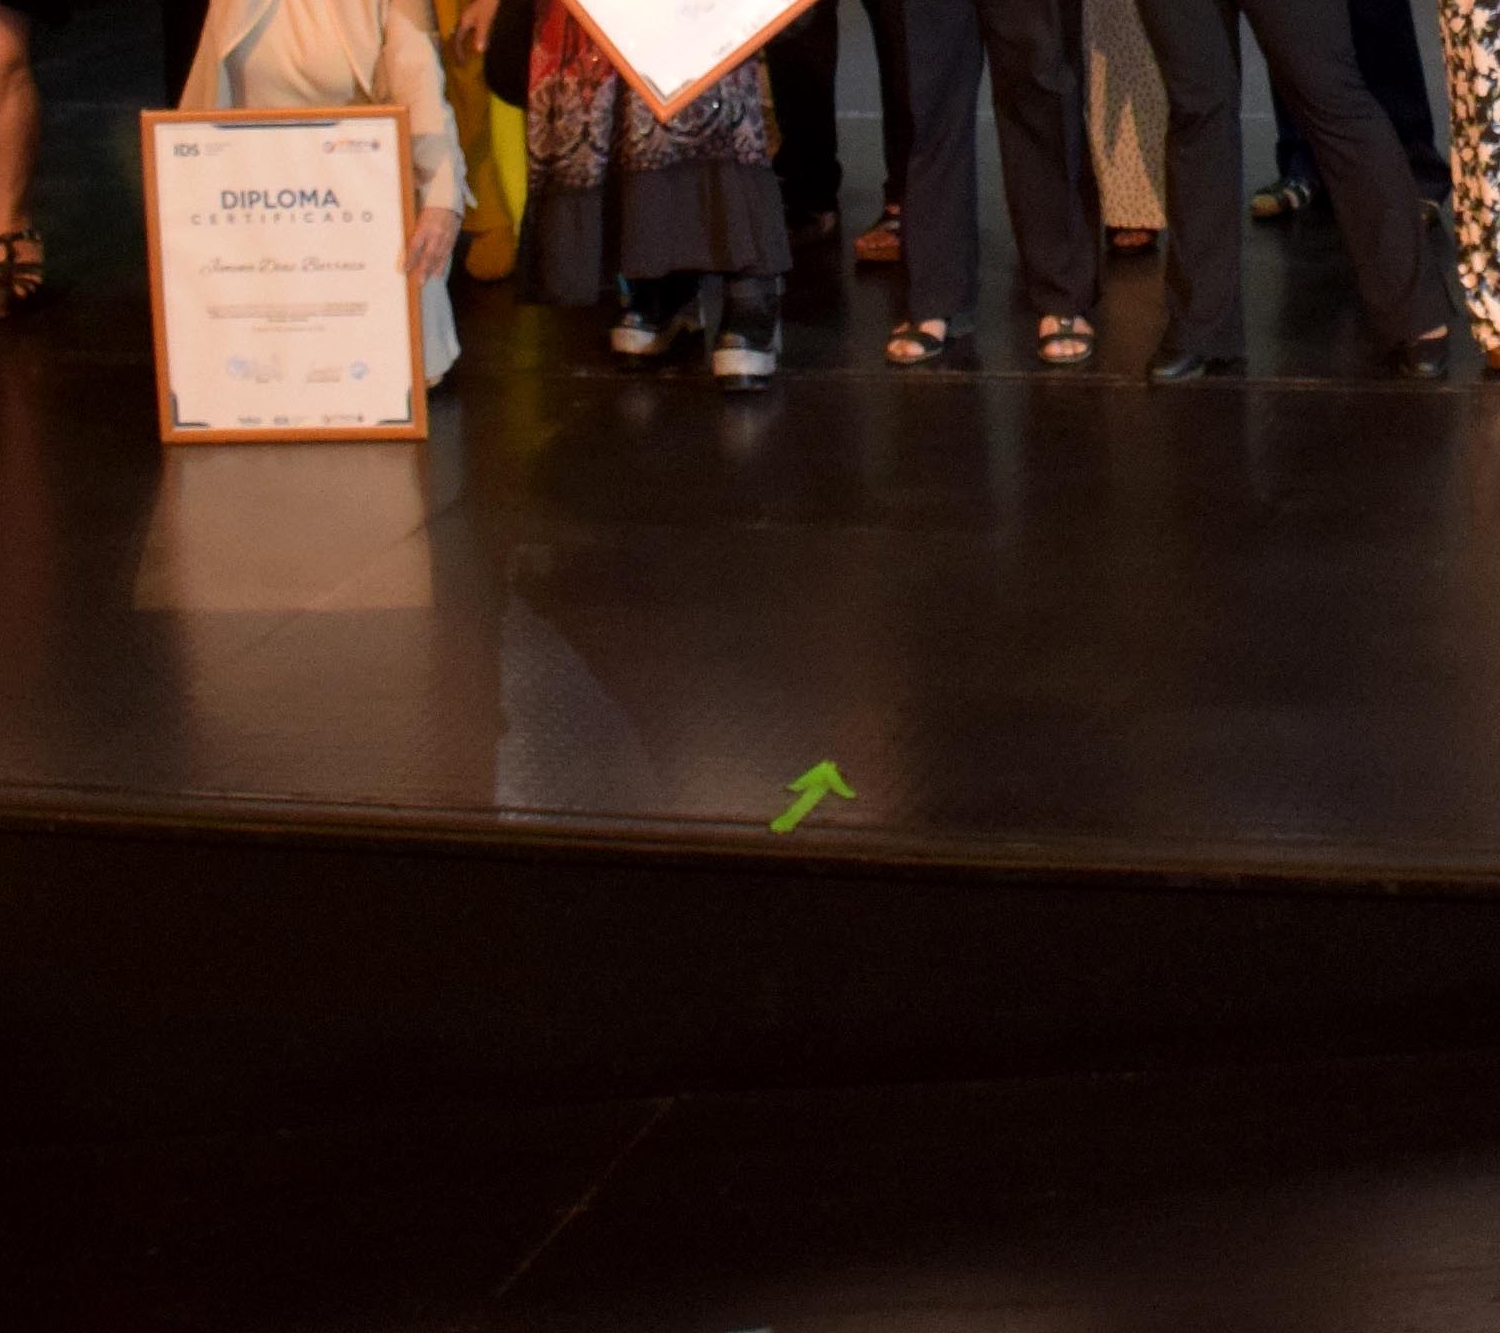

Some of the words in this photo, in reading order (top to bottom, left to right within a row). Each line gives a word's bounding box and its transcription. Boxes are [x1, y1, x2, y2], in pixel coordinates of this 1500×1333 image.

[173, 143, 200, 157] IDS
[220, 188, 340, 210] DIPLOMA
[190, 210, 374, 226] CERTIFICADO
